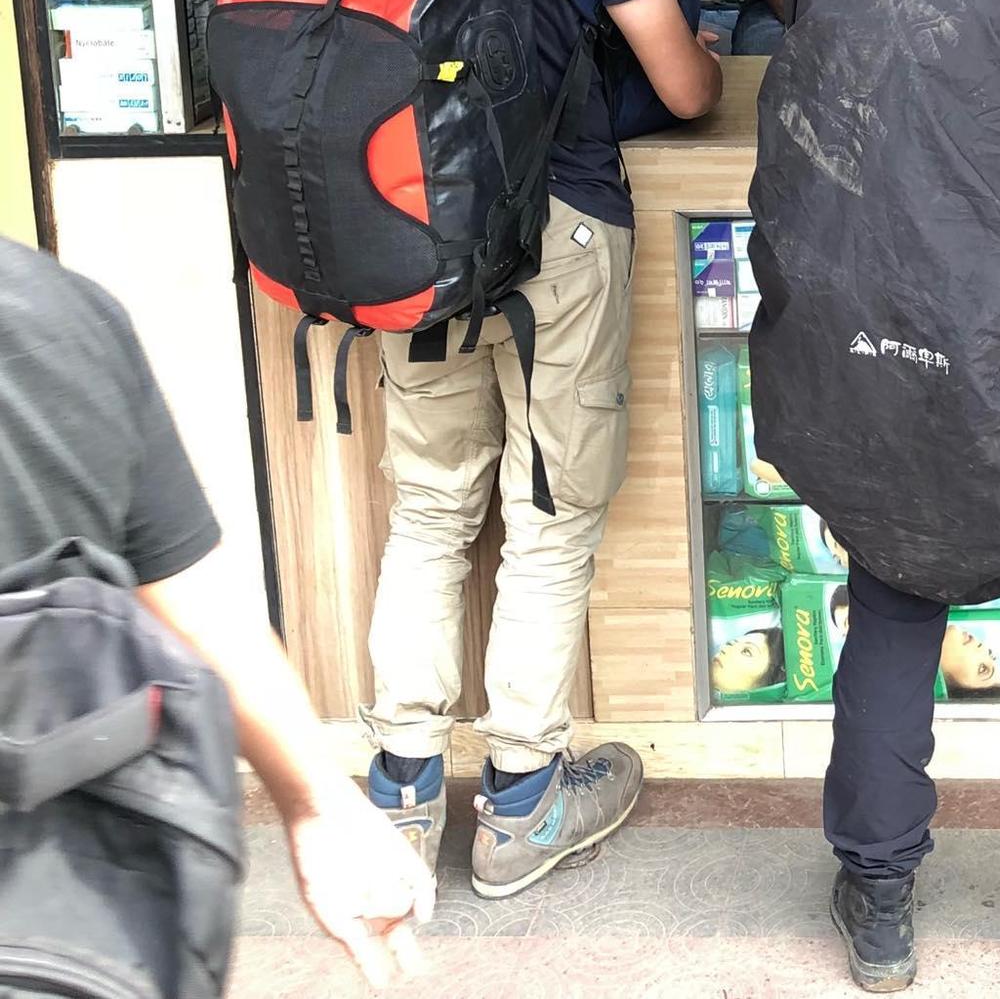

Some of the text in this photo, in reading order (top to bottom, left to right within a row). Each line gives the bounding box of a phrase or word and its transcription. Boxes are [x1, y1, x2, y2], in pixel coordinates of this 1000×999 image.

[880, 338, 950, 375] 阿爾卑斯
[773, 512, 795, 573] enora
[793, 608, 820, 693] Senora
